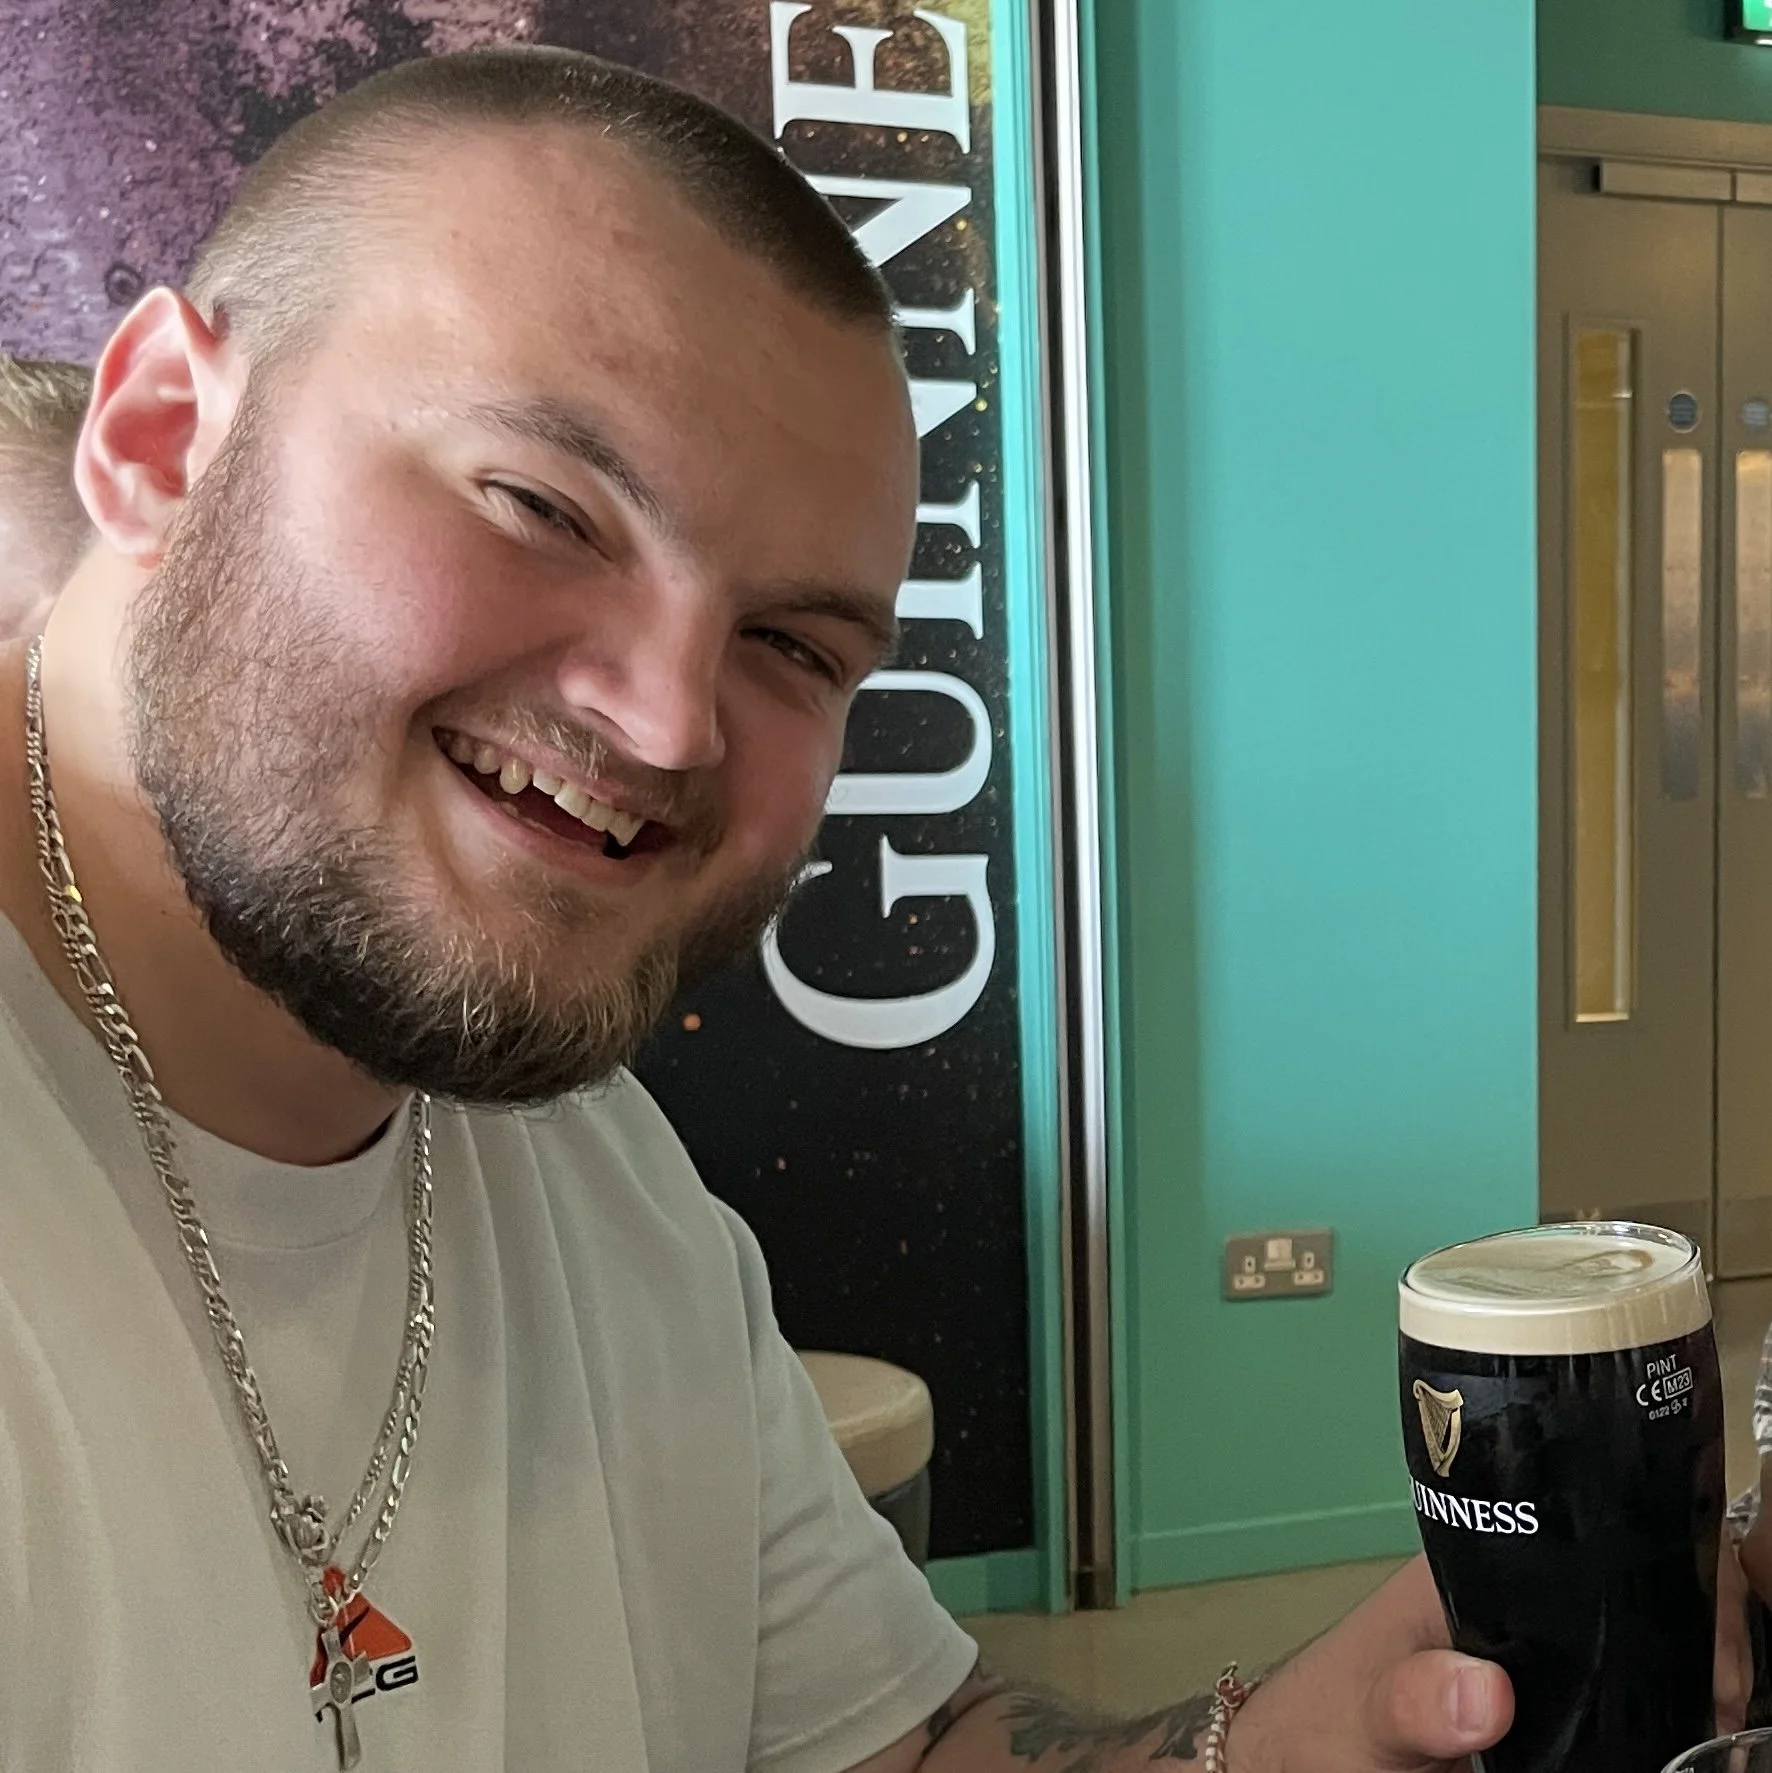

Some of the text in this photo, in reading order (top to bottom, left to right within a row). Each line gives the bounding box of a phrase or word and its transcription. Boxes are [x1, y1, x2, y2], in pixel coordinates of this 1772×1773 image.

[1647, 1353, 1676, 1379] PINT
[1636, 1372, 1690, 1406] CE M23
[1410, 1474, 1539, 1535] UINNESS
